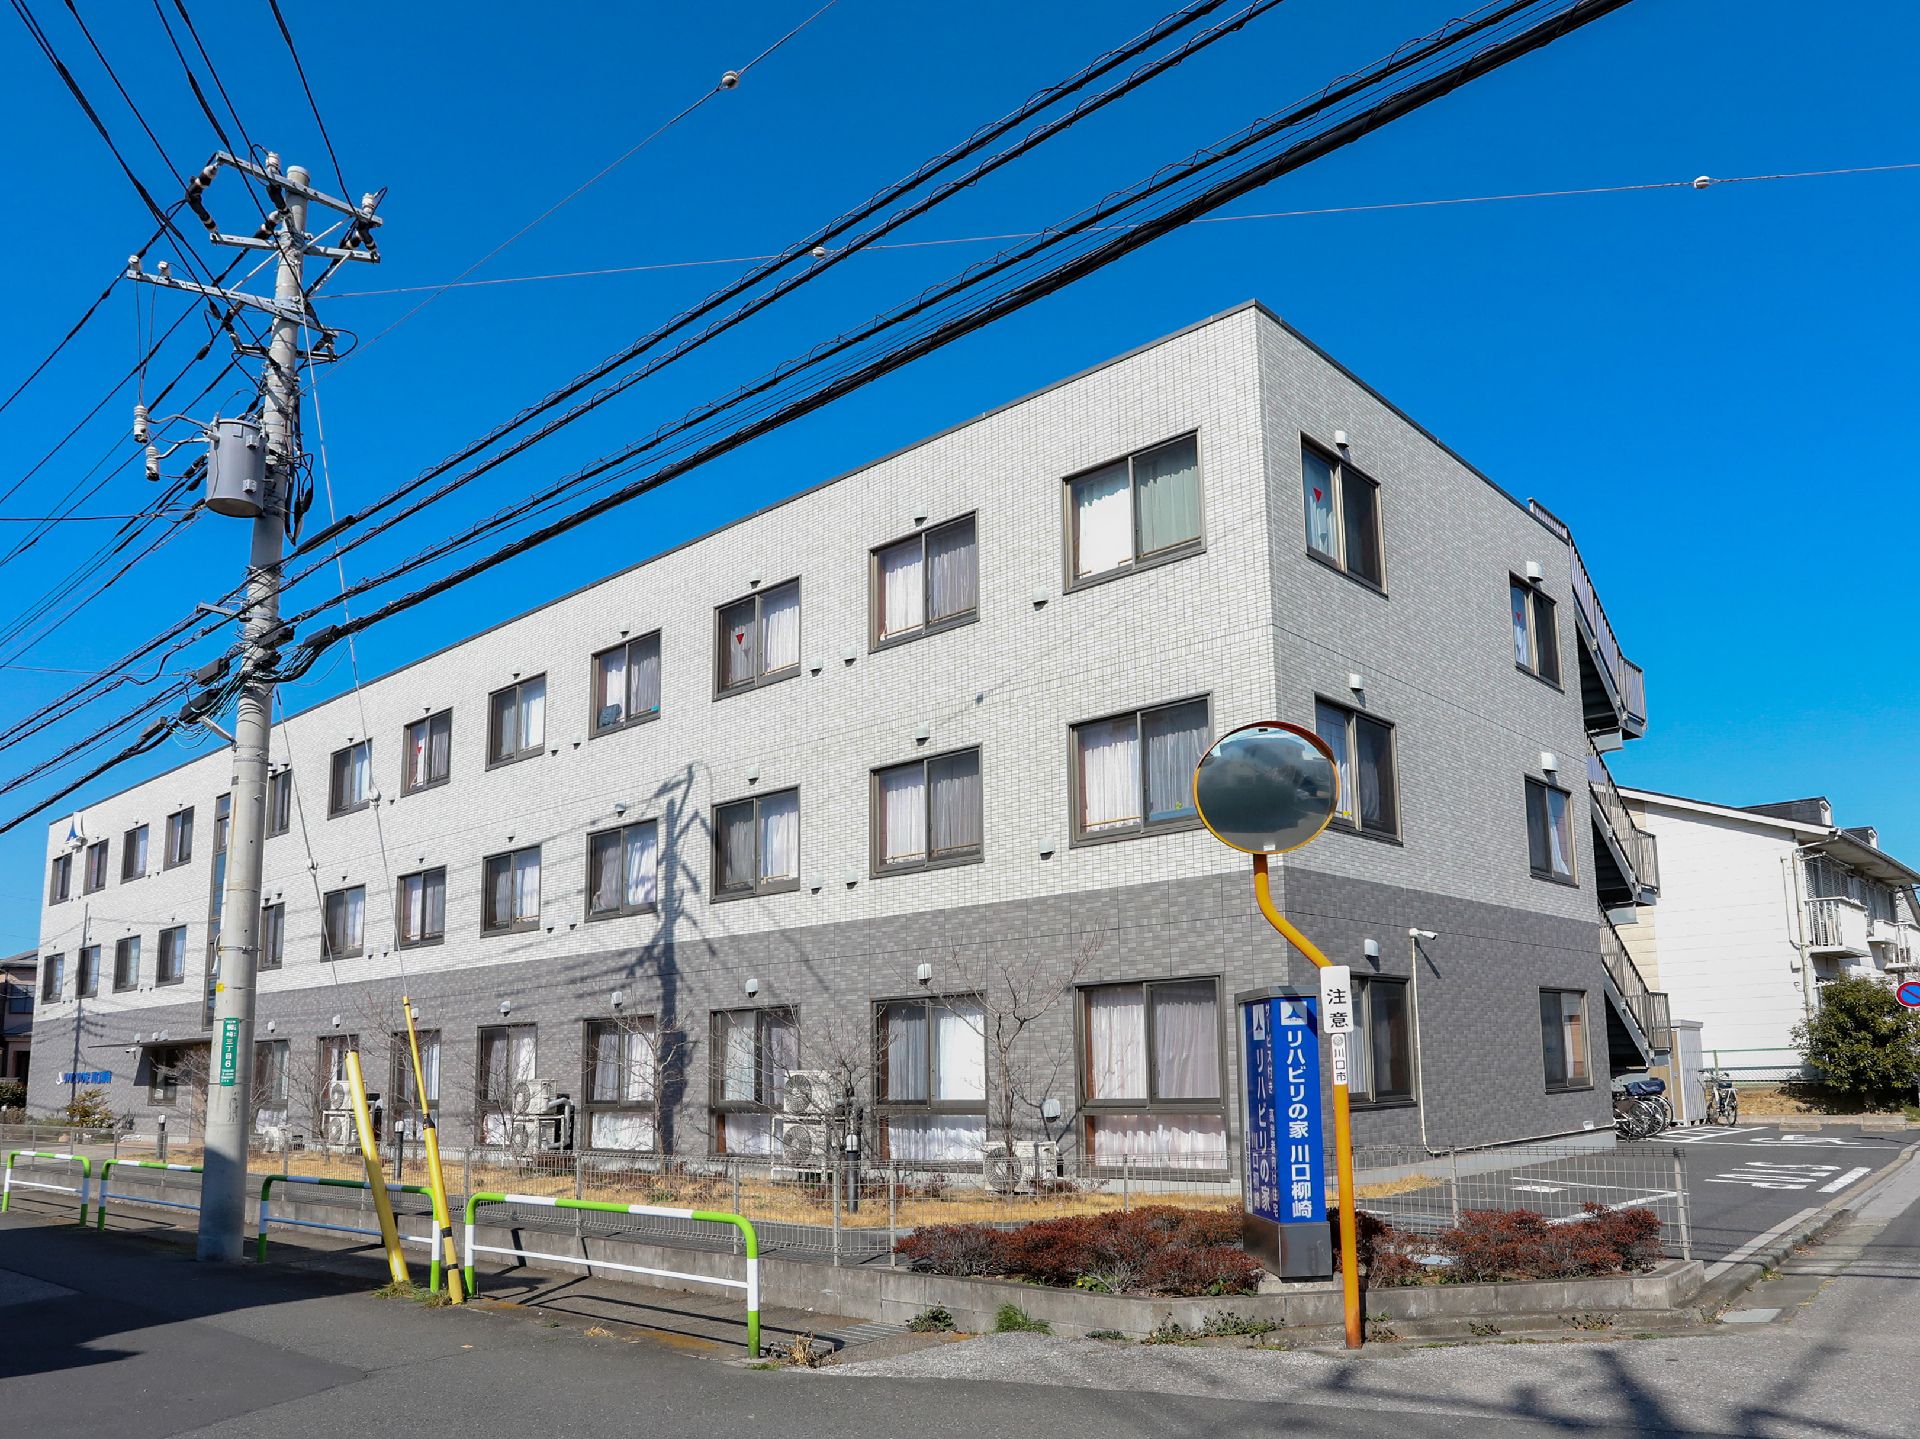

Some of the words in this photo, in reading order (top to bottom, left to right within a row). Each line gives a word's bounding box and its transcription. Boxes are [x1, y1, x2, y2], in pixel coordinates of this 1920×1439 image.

[1327, 988, 1348, 1028] 注意
[1286, 1030, 1309, 1138] リハビリの家
[1334, 1048, 1346, 1082] 川口市
[1256, 1048, 1271, 1212] リハビリの家
[1290, 1144, 1313, 1218] 川口柳崎
[1704, 1161, 1842, 1190] STOP
